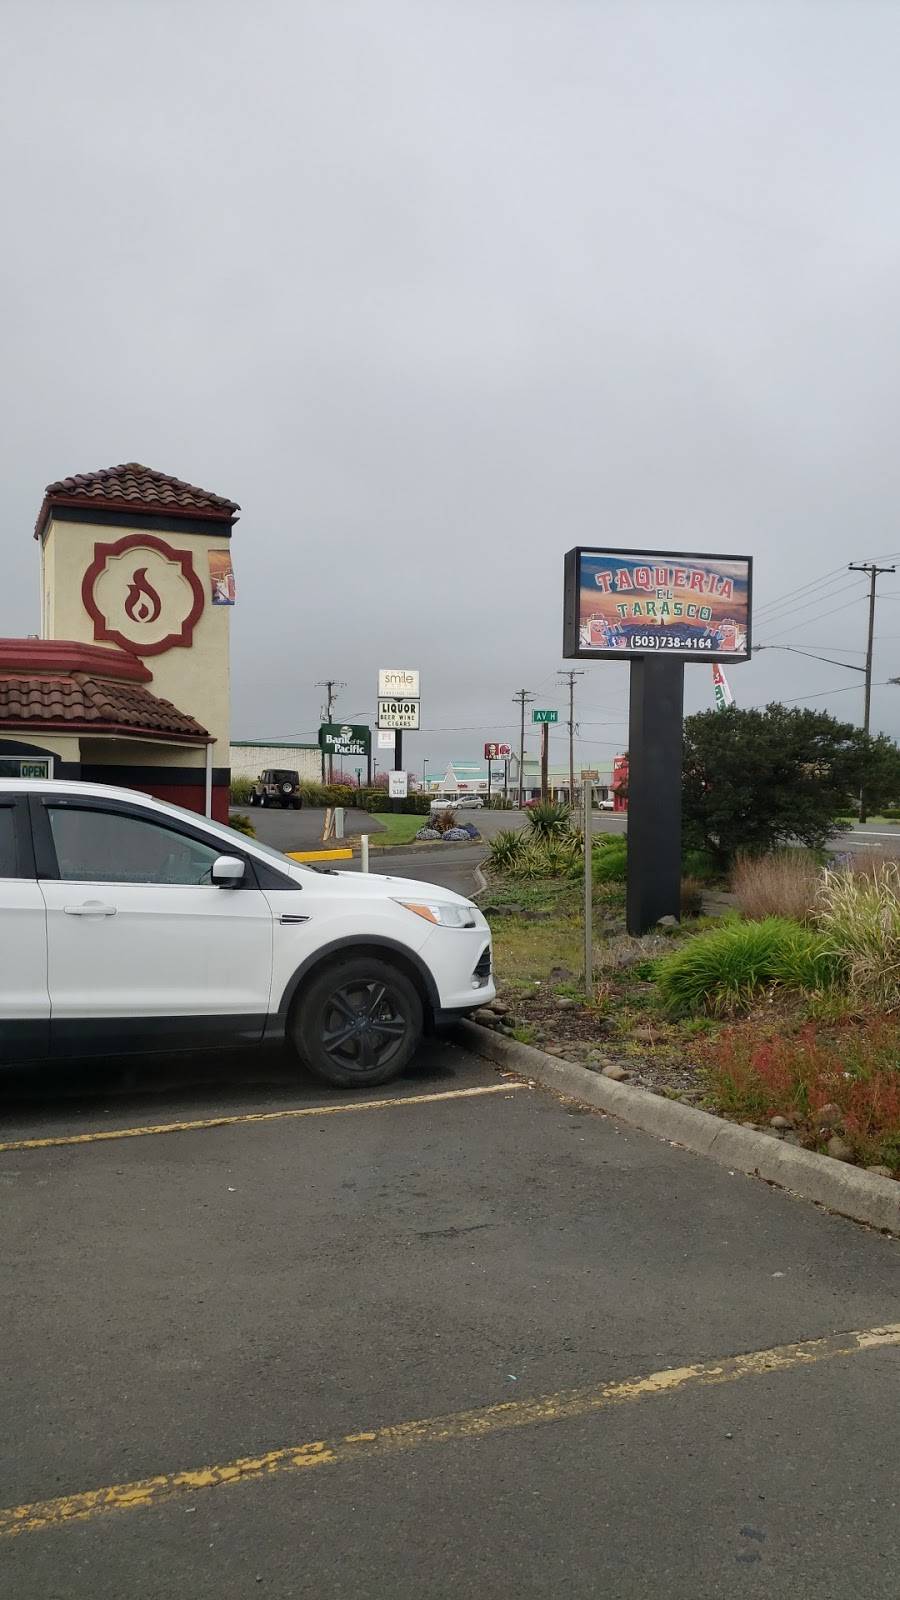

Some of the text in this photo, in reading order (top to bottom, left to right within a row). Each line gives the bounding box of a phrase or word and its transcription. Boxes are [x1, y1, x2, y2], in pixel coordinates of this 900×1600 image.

[595, 566, 734, 600] TAQUERIA
[656, 588, 673, 600] EL
[617, 601, 713, 622] TARASCO
[630, 635, 713, 649] (503)738-4164
[385, 671, 414, 683] smile
[382, 703, 416, 714] LIQUOR
[536, 712, 556, 721] AV H
[326, 734, 350, 745] Bank
[334, 743, 365, 754] Pacific
[22, 765, 46, 778] OPEN
